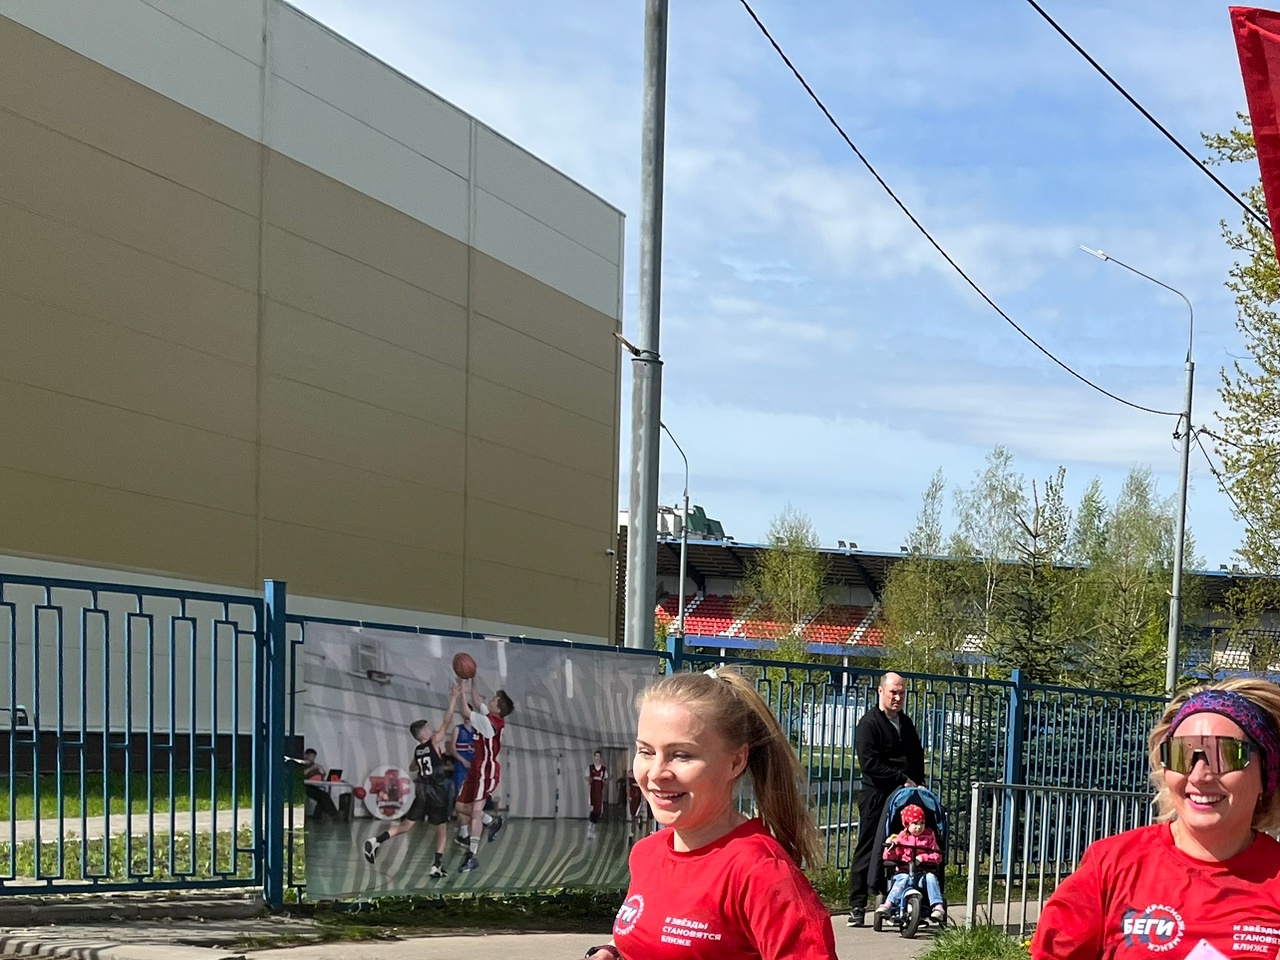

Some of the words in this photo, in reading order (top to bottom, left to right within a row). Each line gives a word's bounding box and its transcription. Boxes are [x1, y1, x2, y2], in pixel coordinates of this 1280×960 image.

[417, 756, 433, 776] 13
[662, 926, 721, 940] СТАНОВЯТСЯ
[1124, 918, 1175, 936] БЕГИ
[661, 935, 692, 946] БЛИЖЕ
[1232, 943, 1269, 953] БЛИЖЕ
